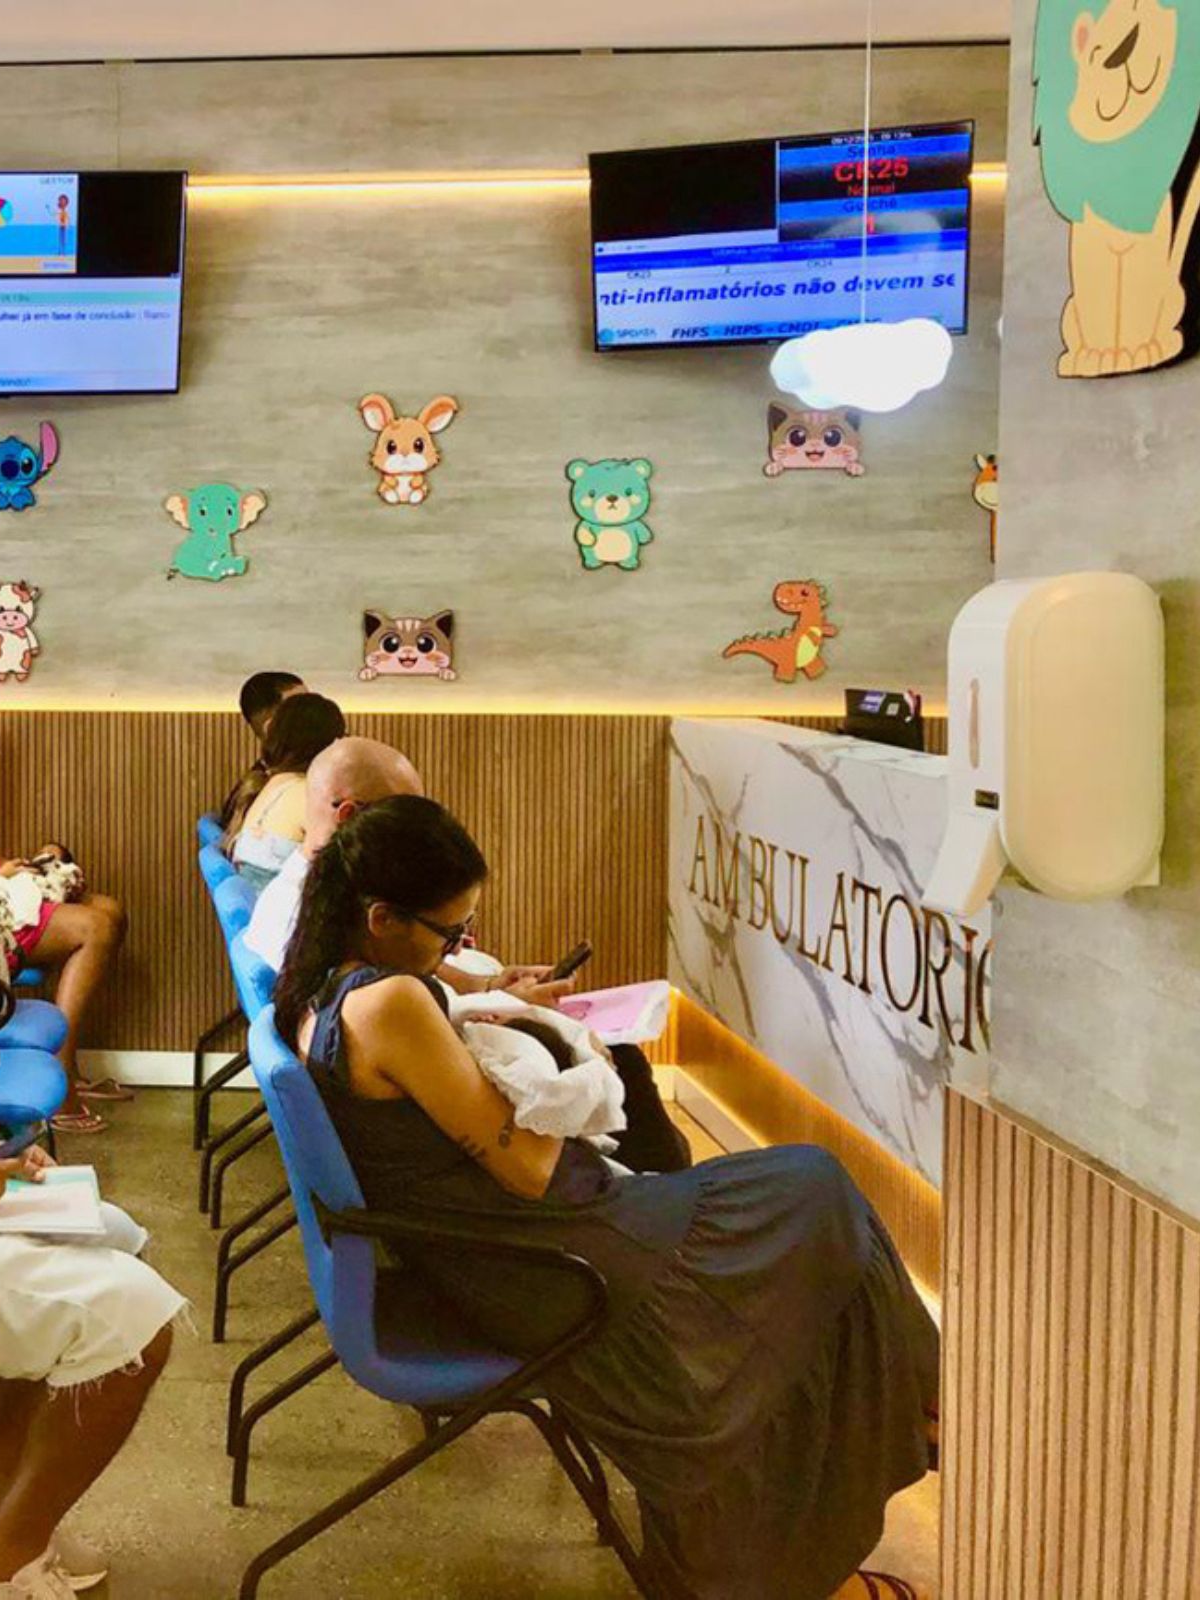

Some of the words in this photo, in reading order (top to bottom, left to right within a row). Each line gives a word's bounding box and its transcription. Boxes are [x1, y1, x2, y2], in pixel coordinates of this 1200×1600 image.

[834, 157, 909, 182] CK25
[793, 277, 837, 295] não
[843, 275, 925, 292] devem
[34, 313, 50, 321] em
[74, 310, 87, 321] de
